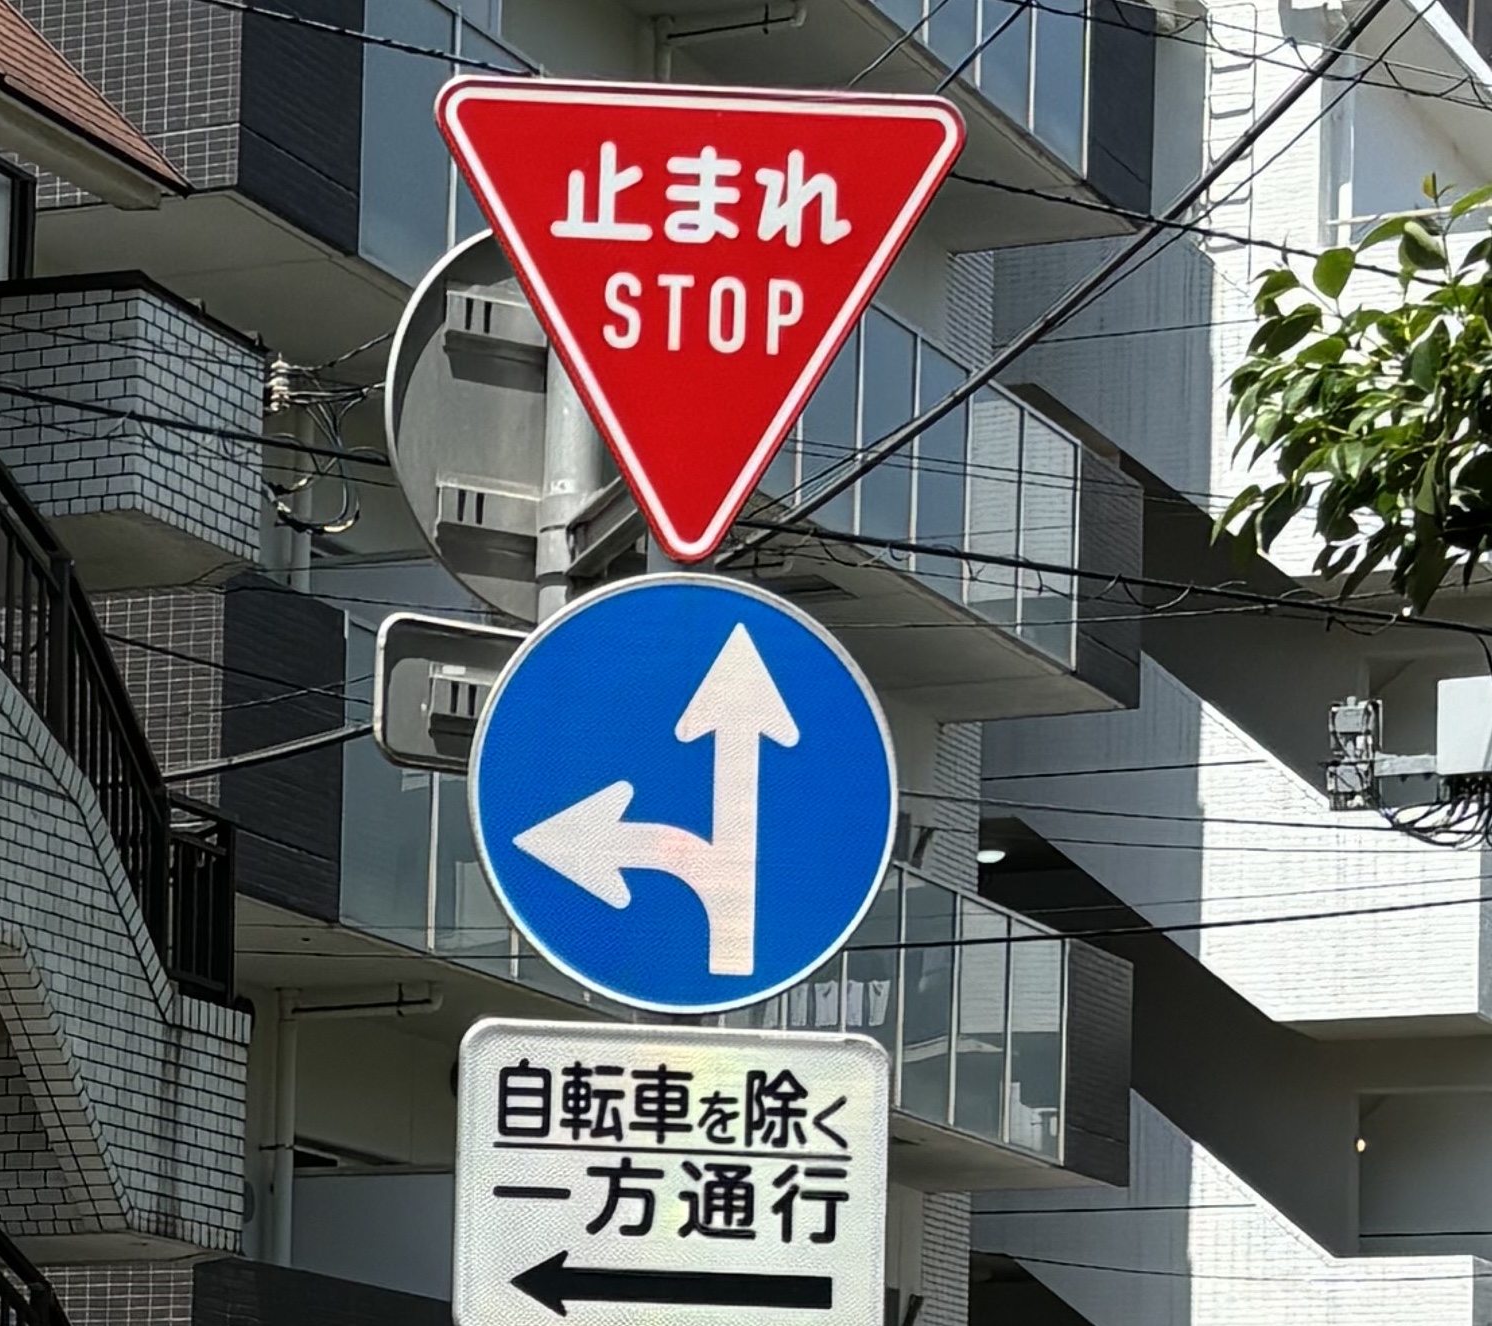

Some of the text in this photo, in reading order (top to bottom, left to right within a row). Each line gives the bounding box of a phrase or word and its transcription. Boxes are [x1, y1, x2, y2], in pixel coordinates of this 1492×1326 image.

[550, 140, 851, 248] 止まれ
[602, 271, 805, 356] STOP
[497, 1058, 849, 1149] 自転車を除く
[493, 1157, 850, 1244] 一方通行
